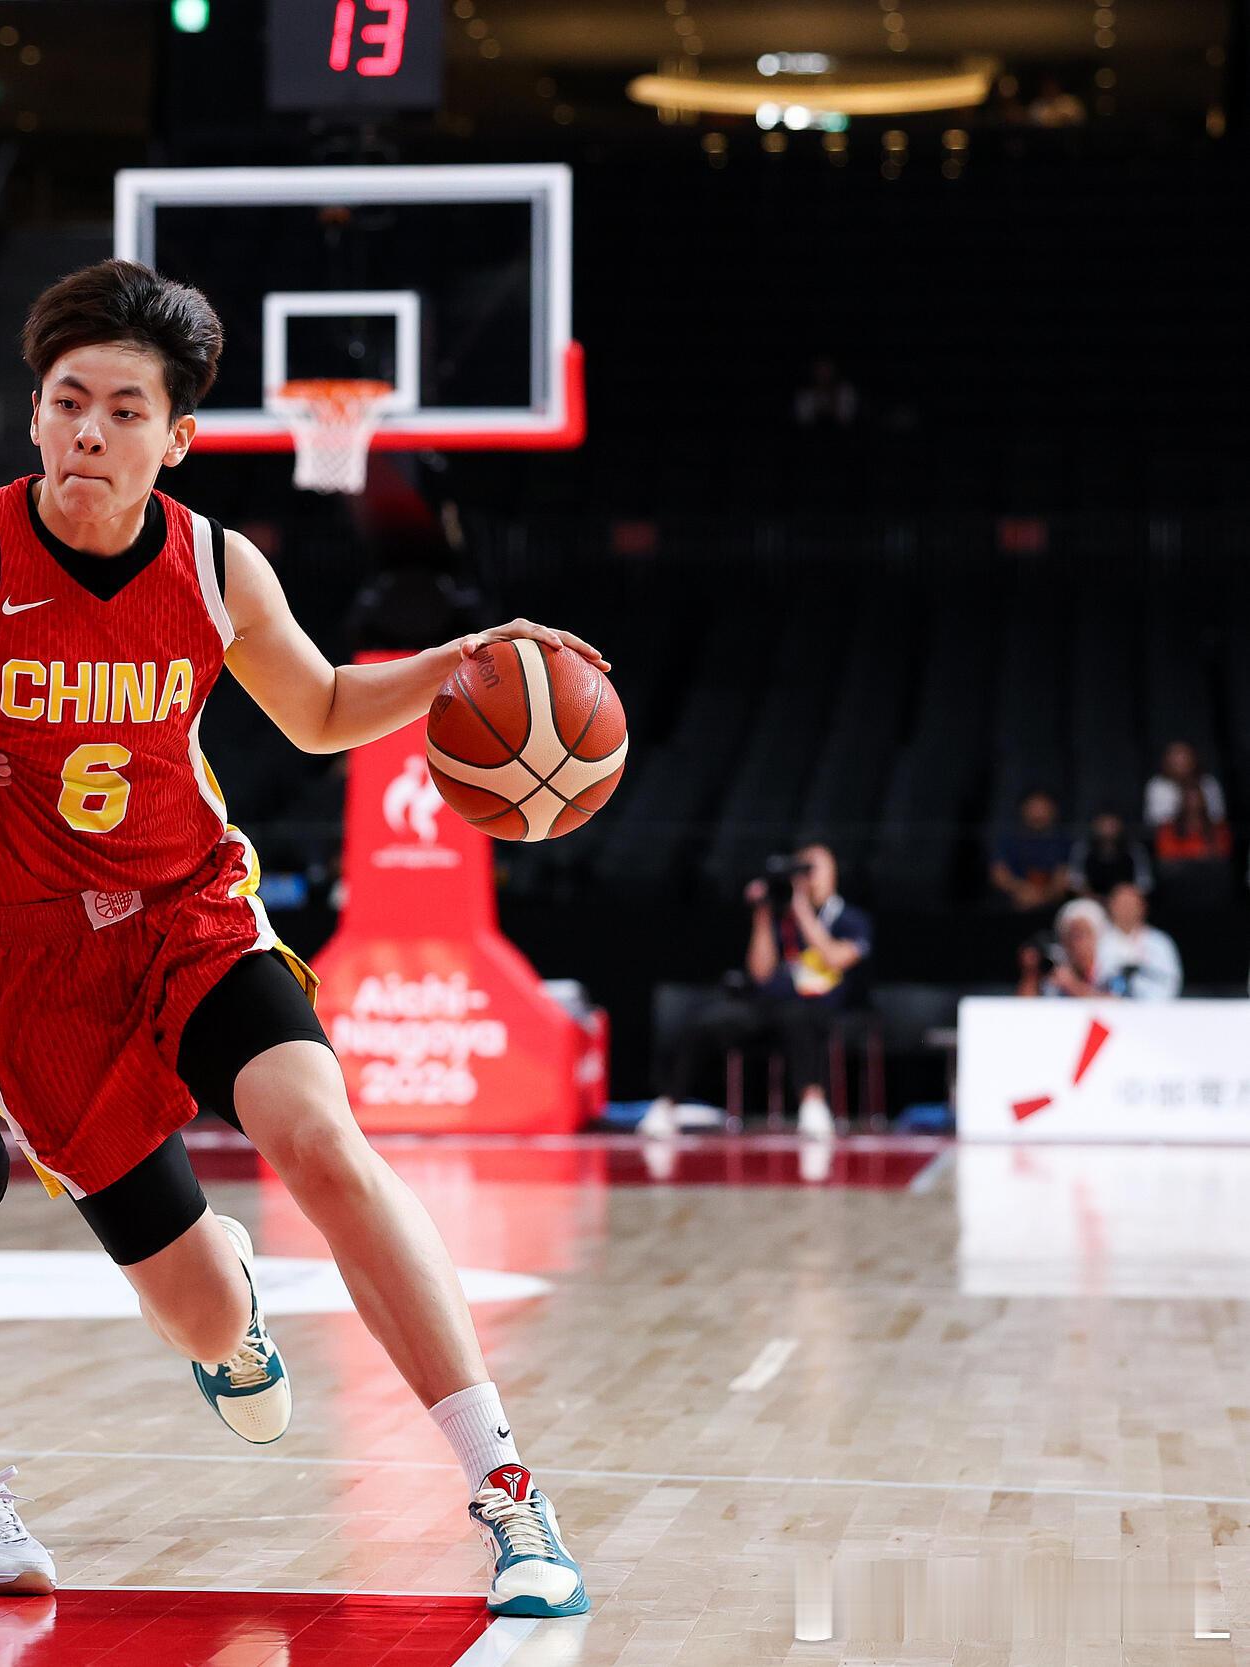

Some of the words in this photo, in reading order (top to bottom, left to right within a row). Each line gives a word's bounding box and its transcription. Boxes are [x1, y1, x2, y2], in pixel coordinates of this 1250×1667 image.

[328, 0, 408, 76] 13
[0, 659, 194, 723] CHINA
[57, 743, 132, 833] 6
[332, 1015, 507, 1065] Nagoya
[360, 1060, 478, 1105] 2026
